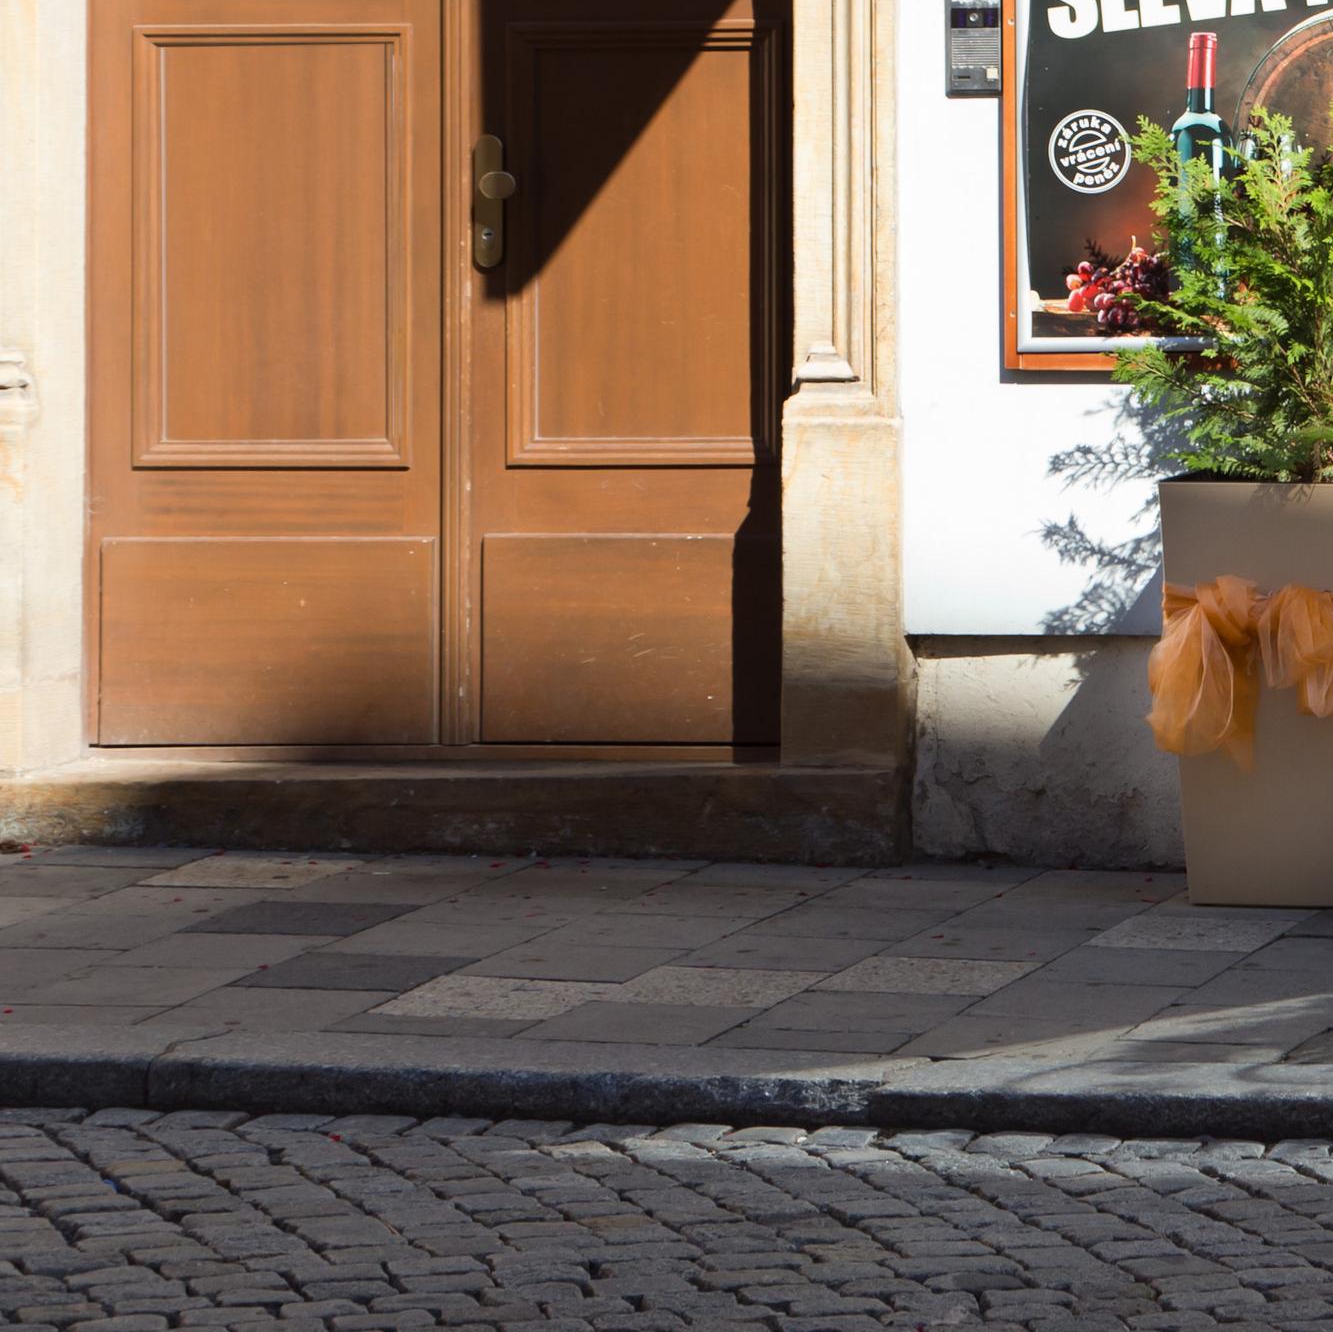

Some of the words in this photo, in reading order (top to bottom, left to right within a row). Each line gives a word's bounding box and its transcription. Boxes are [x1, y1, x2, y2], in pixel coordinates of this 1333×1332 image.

[1057, 115, 1112, 149] záruka
[1059, 138, 1121, 167] vrácení
[1073, 161, 1120, 185] peněz
